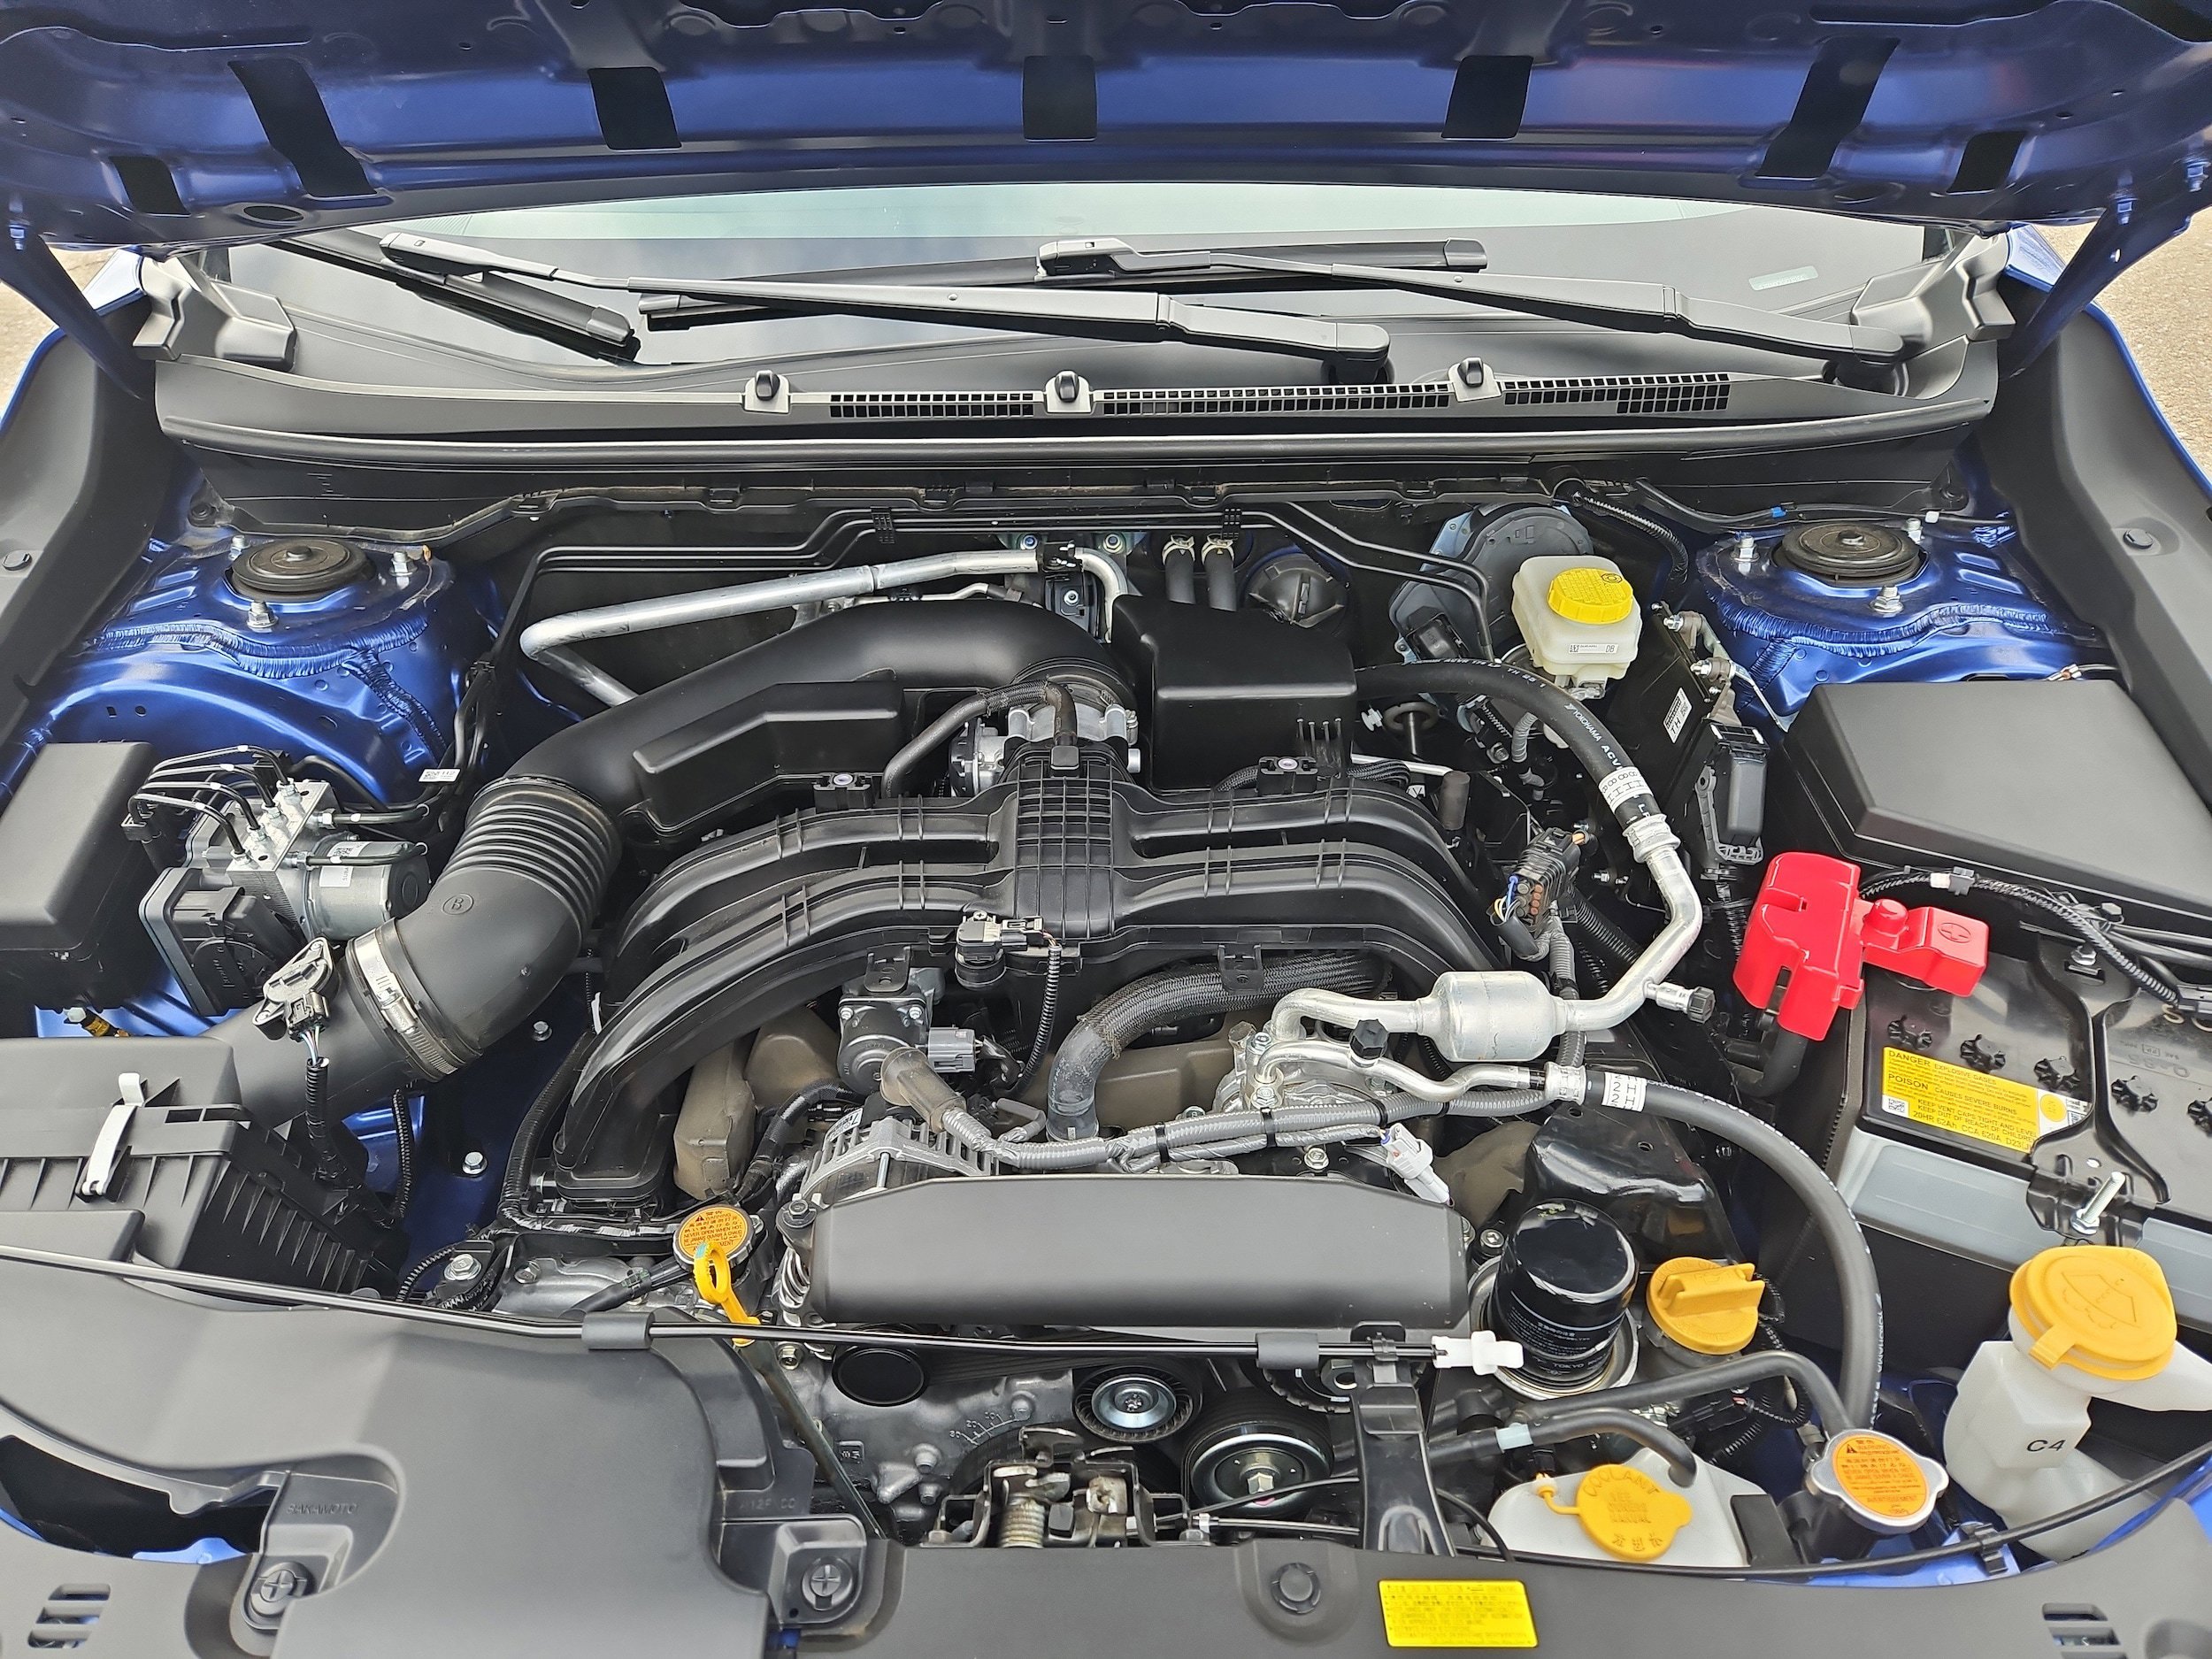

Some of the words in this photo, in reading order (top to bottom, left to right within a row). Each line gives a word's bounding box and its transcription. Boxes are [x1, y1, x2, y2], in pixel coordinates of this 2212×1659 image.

[1888, 1050, 1931, 1067] DANGER
[1934, 1064, 1971, 1078] EXPLOSIVE
[1973, 1074, 1997, 1085] GASES
[1888, 1073, 1929, 1090] POISON
[1934, 1087, 1963, 1100] CAUSES
[1964, 1095, 1992, 1107] SEVERE
[1993, 1103, 2017, 1114] BURNS
[1938, 1105, 1955, 1114] VENT
[1552, 1362, 1585, 1371] TOKYO
[2026, 1439, 2067, 1453] C4
[1582, 1467, 1661, 1497] COOLANT
[286, 1502, 359, 1516] SAKAMOTO
